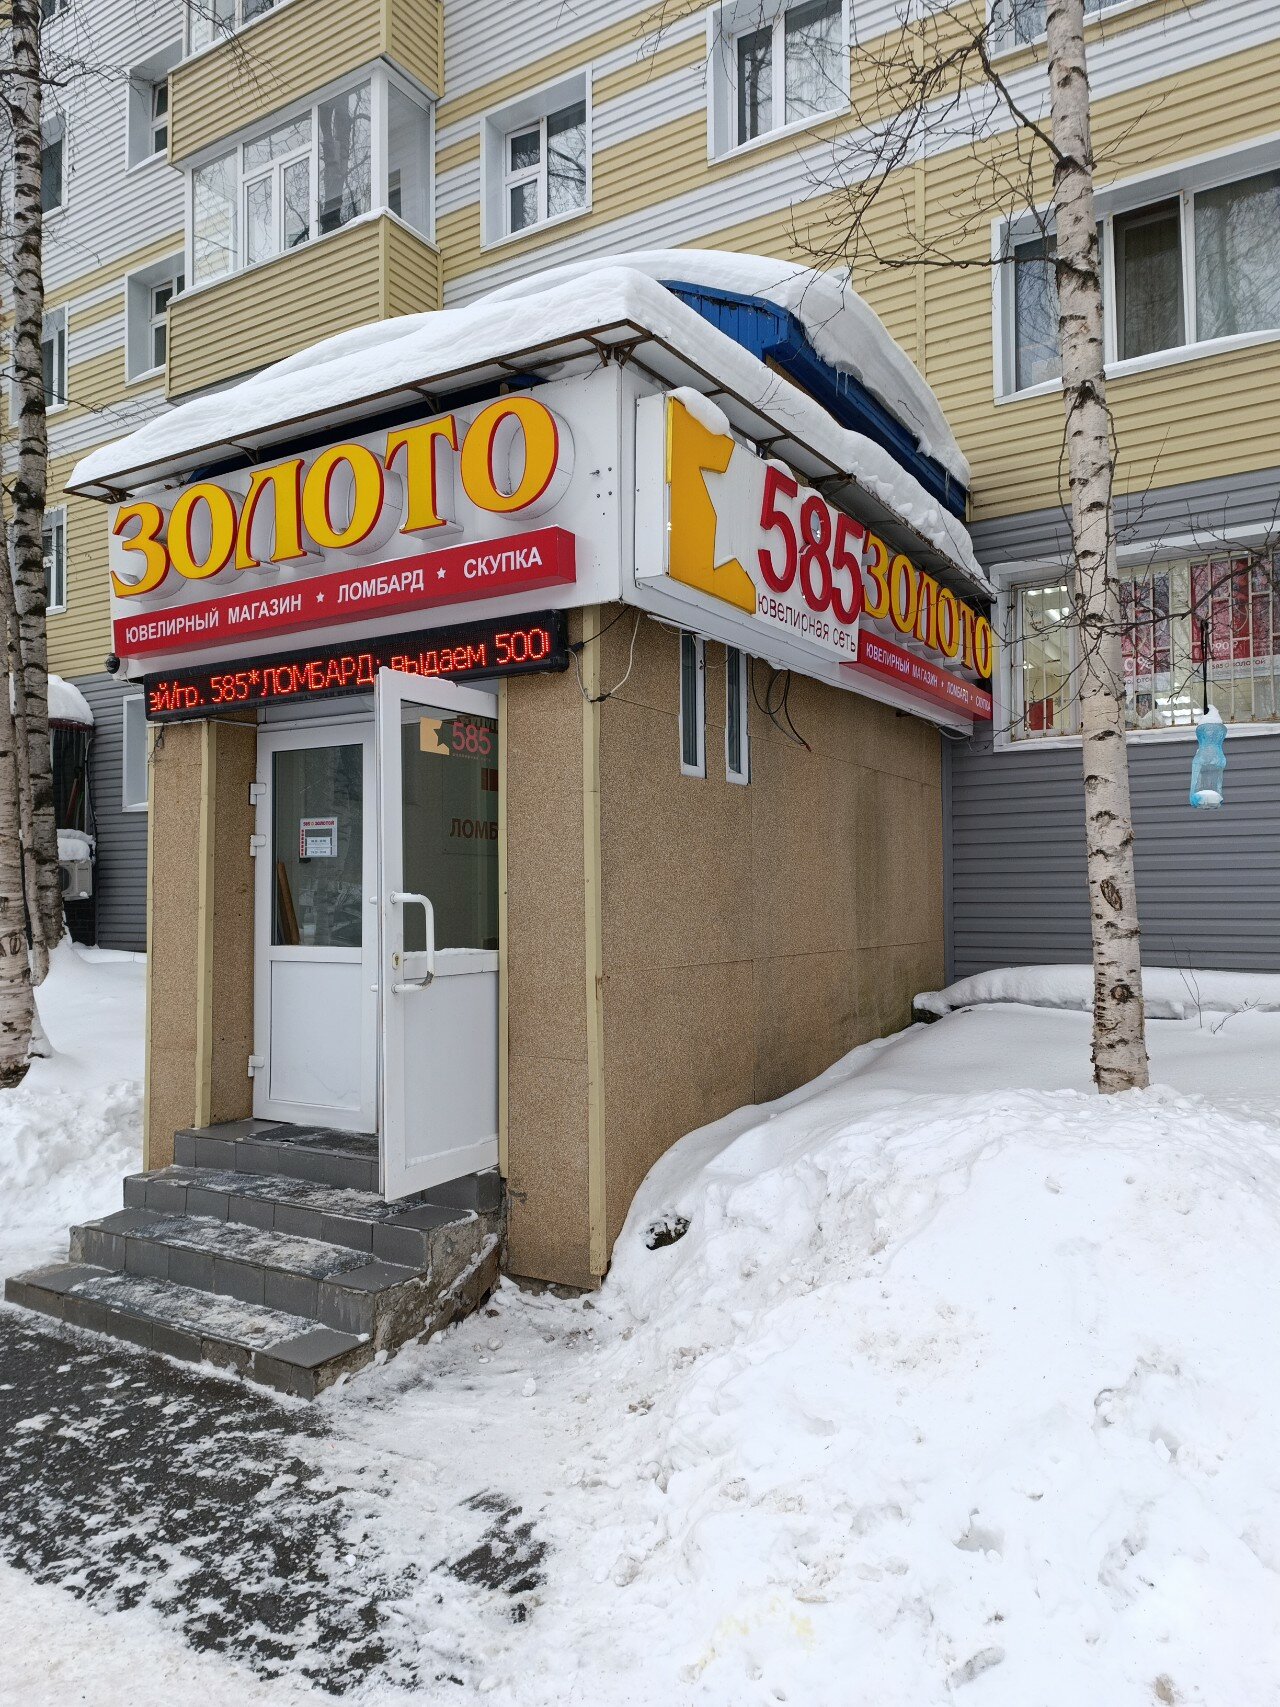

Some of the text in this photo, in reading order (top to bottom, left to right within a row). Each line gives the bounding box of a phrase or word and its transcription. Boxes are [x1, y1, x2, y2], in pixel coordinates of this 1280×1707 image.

[111, 396, 559, 599] ЗОЛОТО
[757, 465, 865, 626] 585
[126, 546, 543, 643] ЮВЕЛИРНЫЙ МАГАЗИН ЛОМБАРД СКУПКА
[758, 593, 857, 653] ювелирная сеть
[862, 530, 993, 679] ЗОЛОТО
[391, 643, 486, 676] выдаем
[866, 642, 910, 674] ЮВЕЛИРНЫЙ
[912, 664, 938, 687] МАГАЗИН
[452, 721, 491, 755] 585
